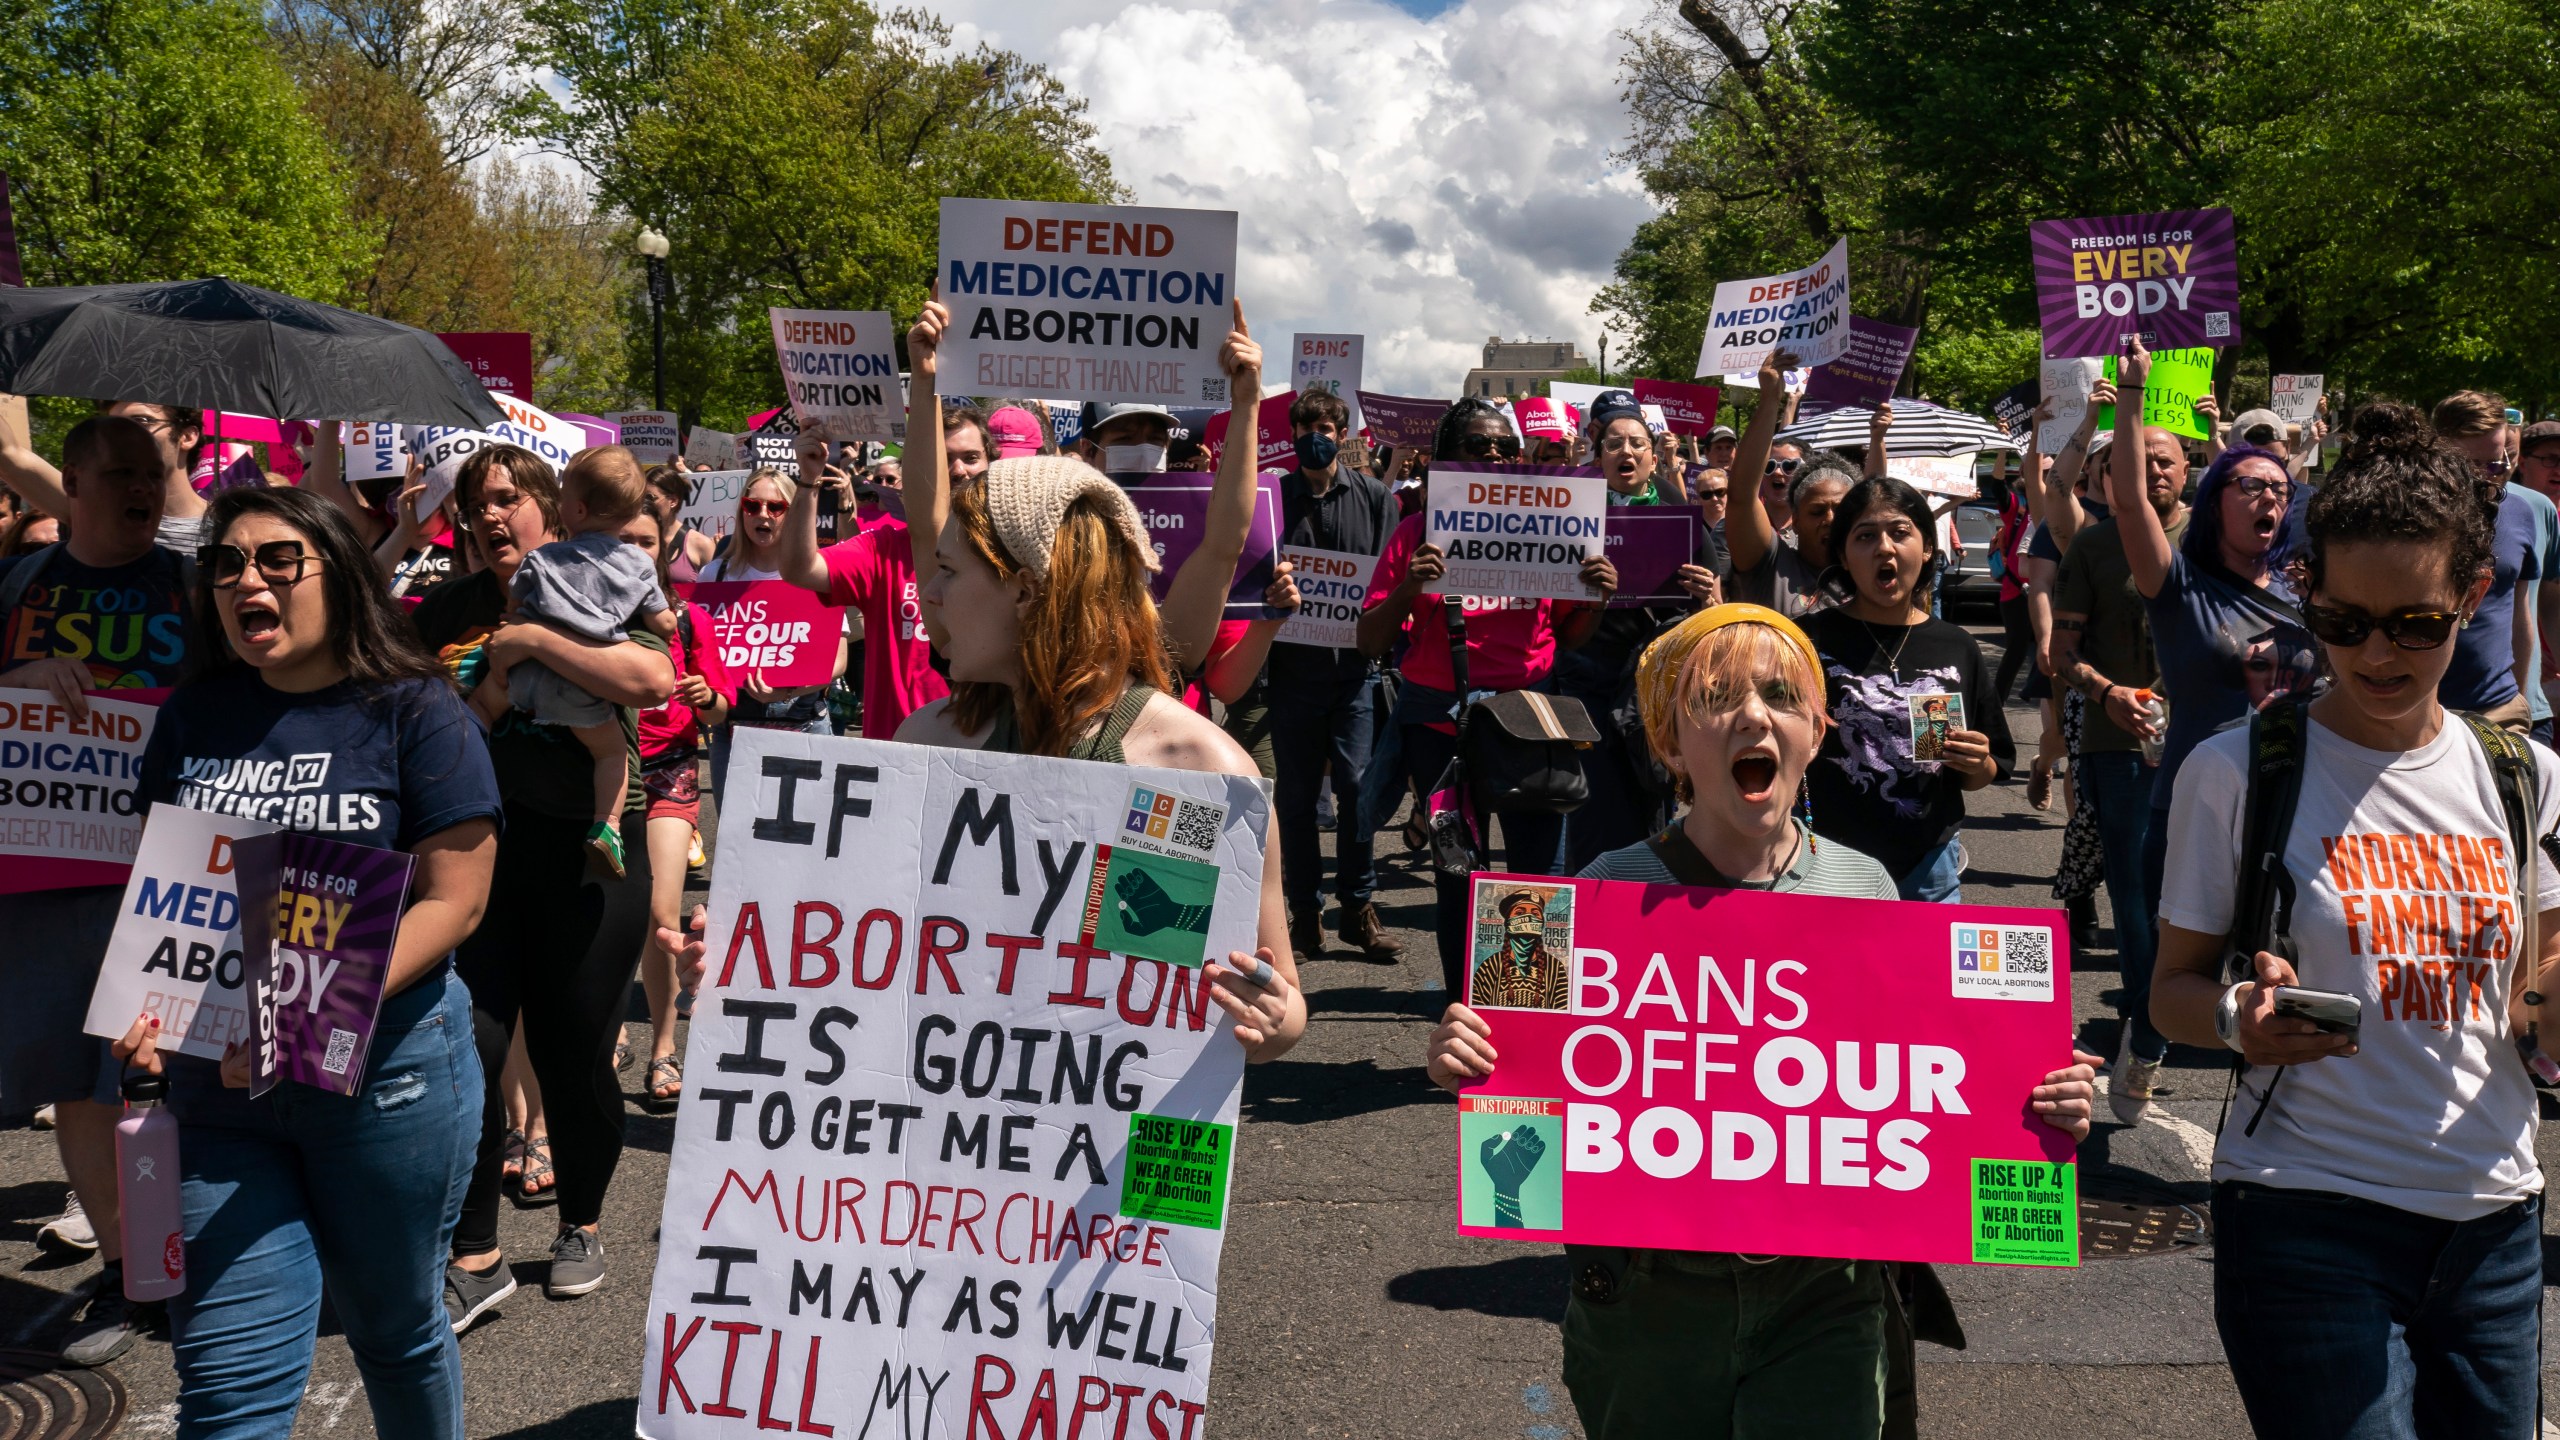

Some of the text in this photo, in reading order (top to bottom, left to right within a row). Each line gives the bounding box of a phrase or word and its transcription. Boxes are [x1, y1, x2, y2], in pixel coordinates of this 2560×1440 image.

[1003, 216, 1175, 258] DEFEND
[2071, 230, 2193, 249] FREEDOM IS FOR
[2072, 244, 2193, 282] EVERY
[950, 259, 1224, 306] MEDICATION
[1748, 263, 1831, 303] DEFEND
[1713, 274, 1845, 328] MEDICATION
[2075, 276, 2196, 319] BODY
[783, 319, 856, 346] DEFEND
[969, 306, 1199, 350] ABORTION
[1720, 306, 1839, 348] ABORTION
[1302, 340, 1350, 358] BANS
[477, 357, 489, 370] is
[978, 353, 1186, 395] BIGGER THAN ROE
[1298, 359, 1328, 376] OFF
[2273, 376, 2320, 392] STOP LAWS
[1363, 404, 1398, 418] We are
[1643, 394, 1693, 408] Abortion is
[1994, 396, 2012, 414] NOT
[2272, 392, 2304, 407] GIVING
[621, 415, 665, 425] DEFEND
[1366, 415, 1383, 425] the
[1679, 408, 1705, 420] Care.
[621, 425, 677, 437] EDICATION
[756, 438, 792, 447] NOT
[1258, 427, 1270, 440] is
[1388, 429, 1398, 438] 10
[1467, 482, 1572, 508] DEFEND
[1433, 509, 1600, 538] MEDICATION
[1445, 538, 1586, 565] ABORTION
[1448, 567, 1575, 593] BIGGER THAN ROE
[26, 584, 68, 608] OT
[1299, 600, 1362, 622] RTION
[745, 621, 811, 646] OUR
[1303, 623, 1336, 642] THAN
[178, 756, 286, 794] YOUNG
[176, 785, 381, 832] INVINCIBLES
[55, 821, 115, 854] THAN
[752, 755, 1087, 937] IF My
[1121, 835, 1210, 865] BUY LOCAL ABORTIONS
[2321, 832, 2511, 897] WORKING
[301, 869, 358, 897] IS FOR
[1082, 857, 1110, 935] UNSTOPPABLE
[134, 876, 241, 932] MED
[2341, 894, 2515, 961] FAMILIES
[142, 935, 245, 991] ABO
[715, 899, 1216, 1032] ABORTION
[1571, 947, 1810, 1031] BANS
[1958, 976, 2050, 988] BUY LOCAL ABORTIONS
[2377, 959, 2492, 1022] PARTY
[257, 979, 275, 1078] NOT
[717, 998, 1148, 1112] IS GOING
[1561, 1024, 1972, 1116] OFF OUR
[1473, 1098, 1550, 1116] UNSTOPPABLE
[699, 1087, 1109, 1187] TO GET ME A
[1136, 1119, 1220, 1151] RISE UP 4
[1566, 1102, 1931, 1193] BODIES
[1134, 1142, 1218, 1166] Abortion Rights!
[1135, 1160, 1213, 1187] WEAR GREEN
[1978, 1163, 2063, 1189] RISE UP 4
[1131, 1178, 1212, 1205] for Abortion
[1978, 1187, 2064, 1204] Abortion Rights!
[701, 1167, 1171, 1267] MURDER CHARGE
[1982, 1205, 2062, 1226] WEAR GREEN
[1981, 1223, 2064, 1243] for Abortion
[690, 1245, 1189, 1373] I MAY AS WELL
[657, 1312, 1206, 1440] KILL MY RAPIST
